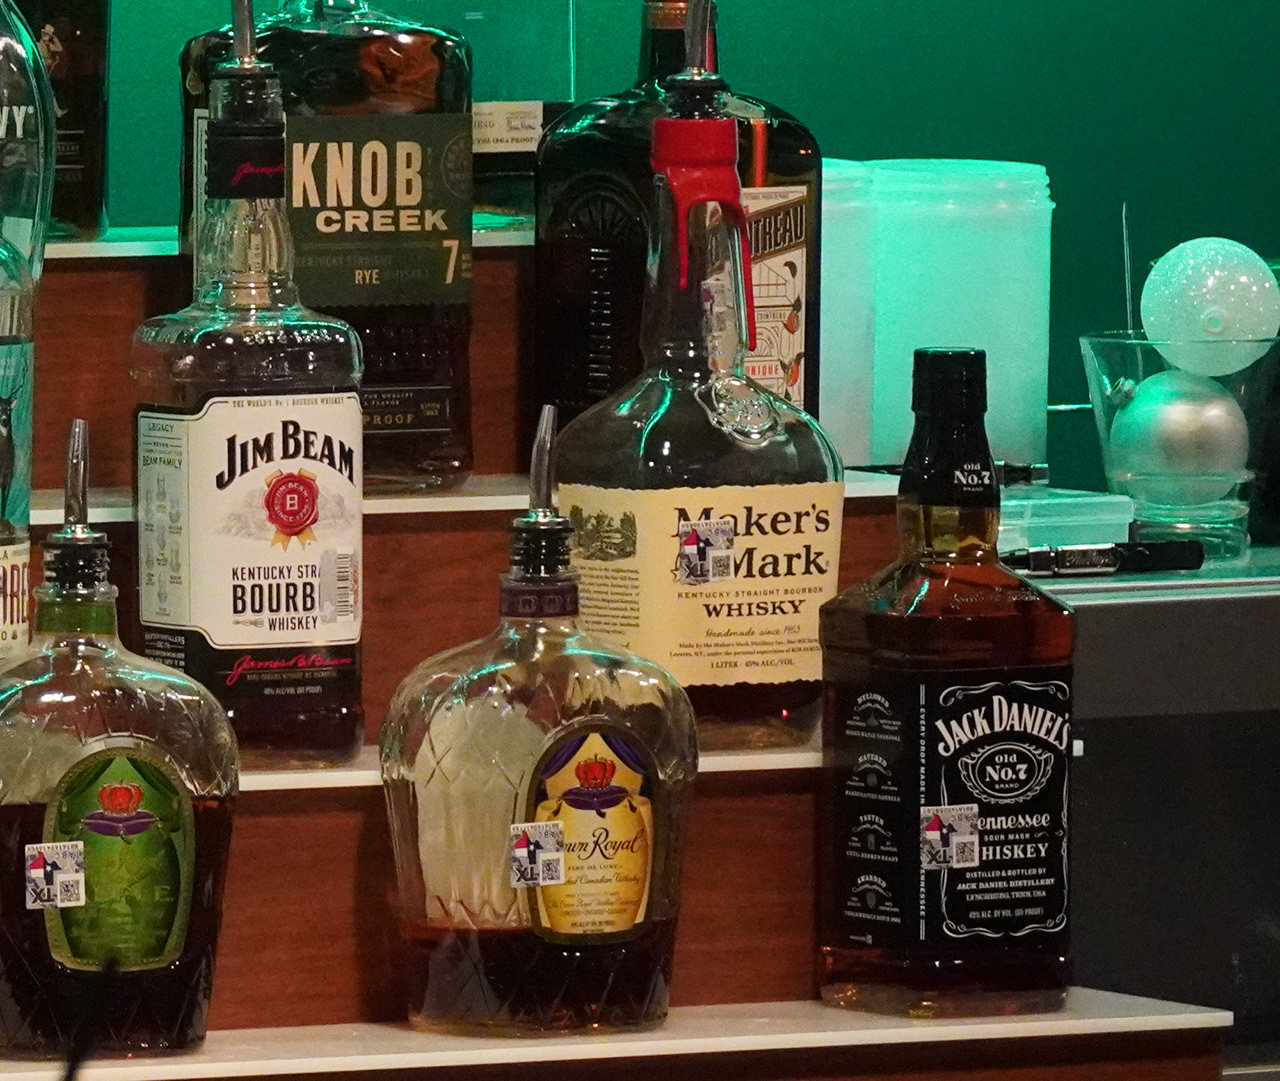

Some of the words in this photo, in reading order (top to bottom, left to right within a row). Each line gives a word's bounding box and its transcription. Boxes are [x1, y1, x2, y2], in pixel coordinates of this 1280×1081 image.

[292, 140, 424, 208] KNOB
[315, 208, 449, 234] CREEK
[442, 239, 460, 285] 7
[354, 269, 381, 286] RYE
[147, 422, 174, 434] LEGACY
[215, 431, 275, 491] JIM
[280, 419, 356, 488] BEAM
[963, 462, 981, 471] Old
[953, 470, 991, 485] No.7
[232, 565, 292, 581] KENTUCKY
[232, 582, 320, 616] BOURB
[678, 590, 731, 599] KENTUCKY
[734, 589, 780, 598] STRAIGHT
[784, 586, 824, 595] BOURBON
[702, 599, 806, 619] WHISKY
[268, 615, 318, 632] WHISKEY
[705, 626, 756, 639] Handmade
[759, 628, 781, 636] since
[935, 705, 989, 757] JACK
[992, 695, 1073, 752] DANIEL'S
[994, 753, 1018, 765] Old
[984, 764, 1029, 783] No.7
[578, 827, 644, 860] Royal
[957, 882, 977, 890] JACK
[979, 881, 1008, 889] DANIEL
[1009, 878, 1055, 886] DISTILLERY
